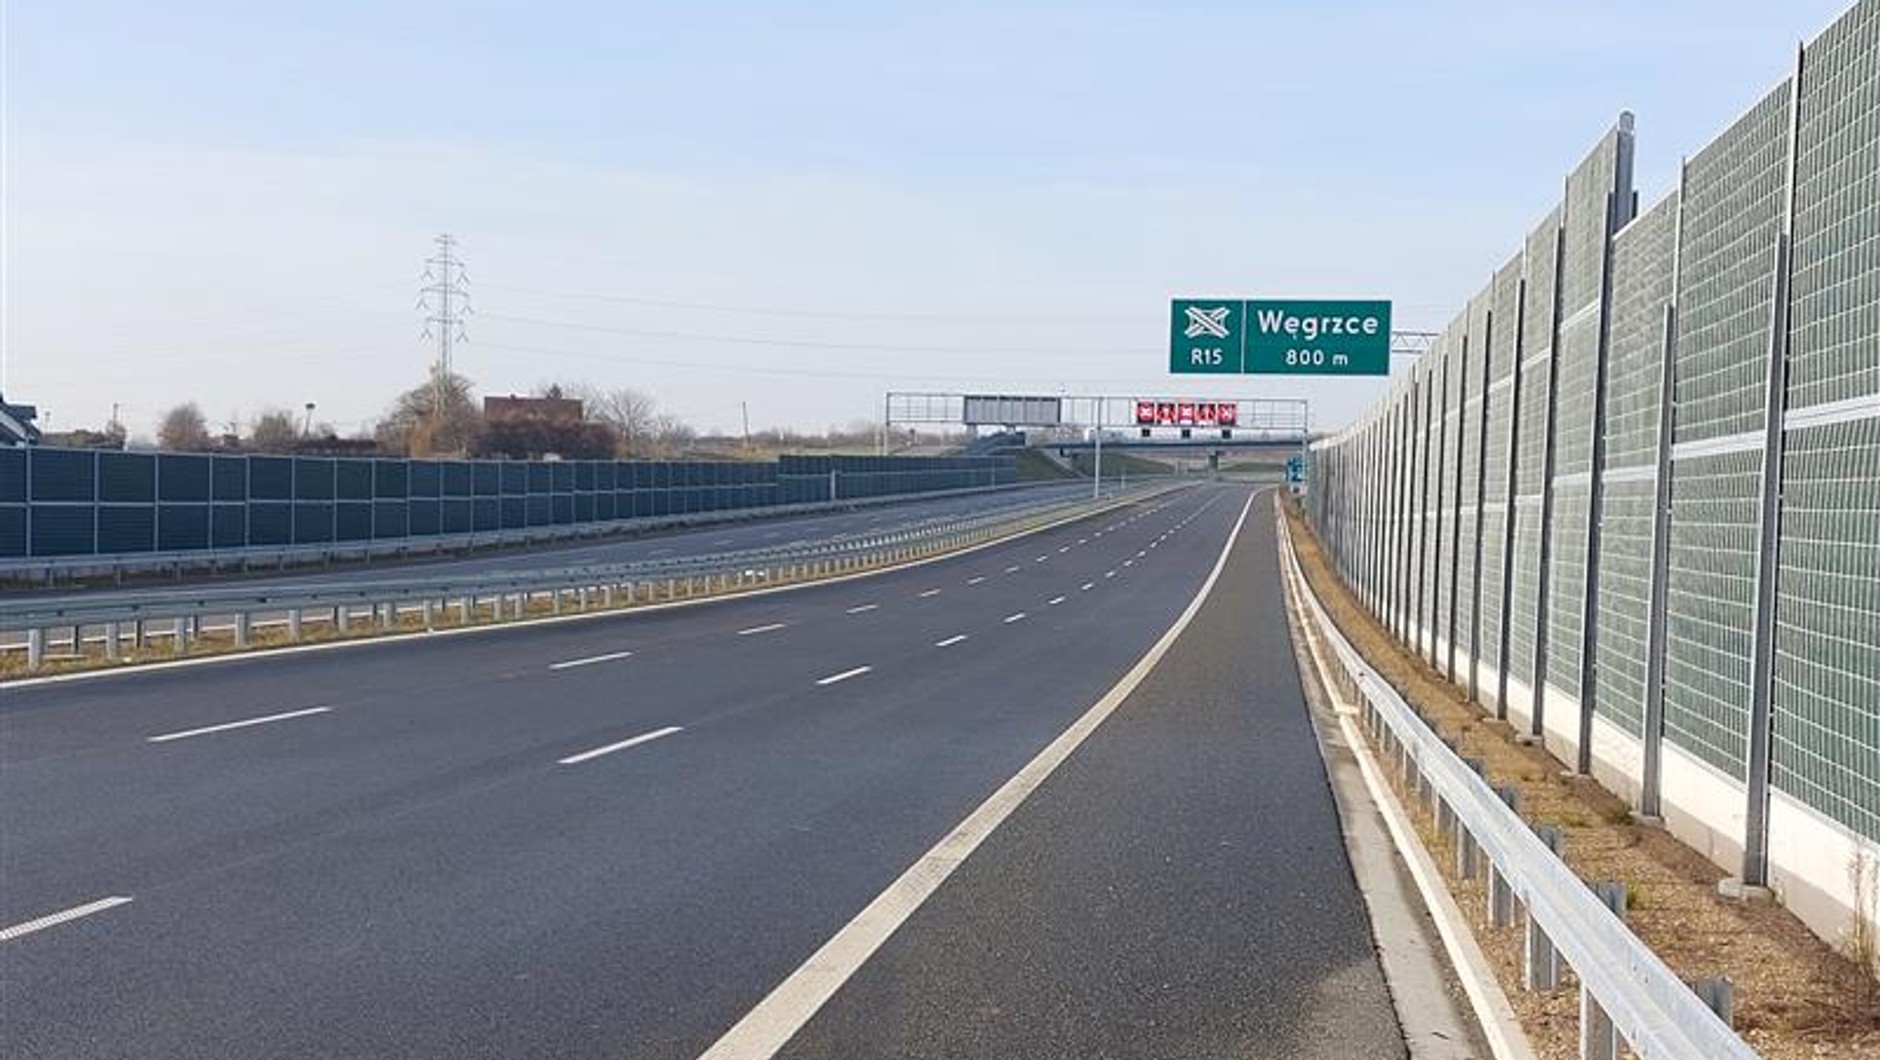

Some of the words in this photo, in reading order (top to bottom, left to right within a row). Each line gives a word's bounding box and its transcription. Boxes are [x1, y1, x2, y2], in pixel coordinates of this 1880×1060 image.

[1258, 310, 1378, 340] Węgrzce
[1190, 348, 1223, 365] R15
[1286, 349, 1324, 366] 800
[1332, 352, 1349, 366] m
